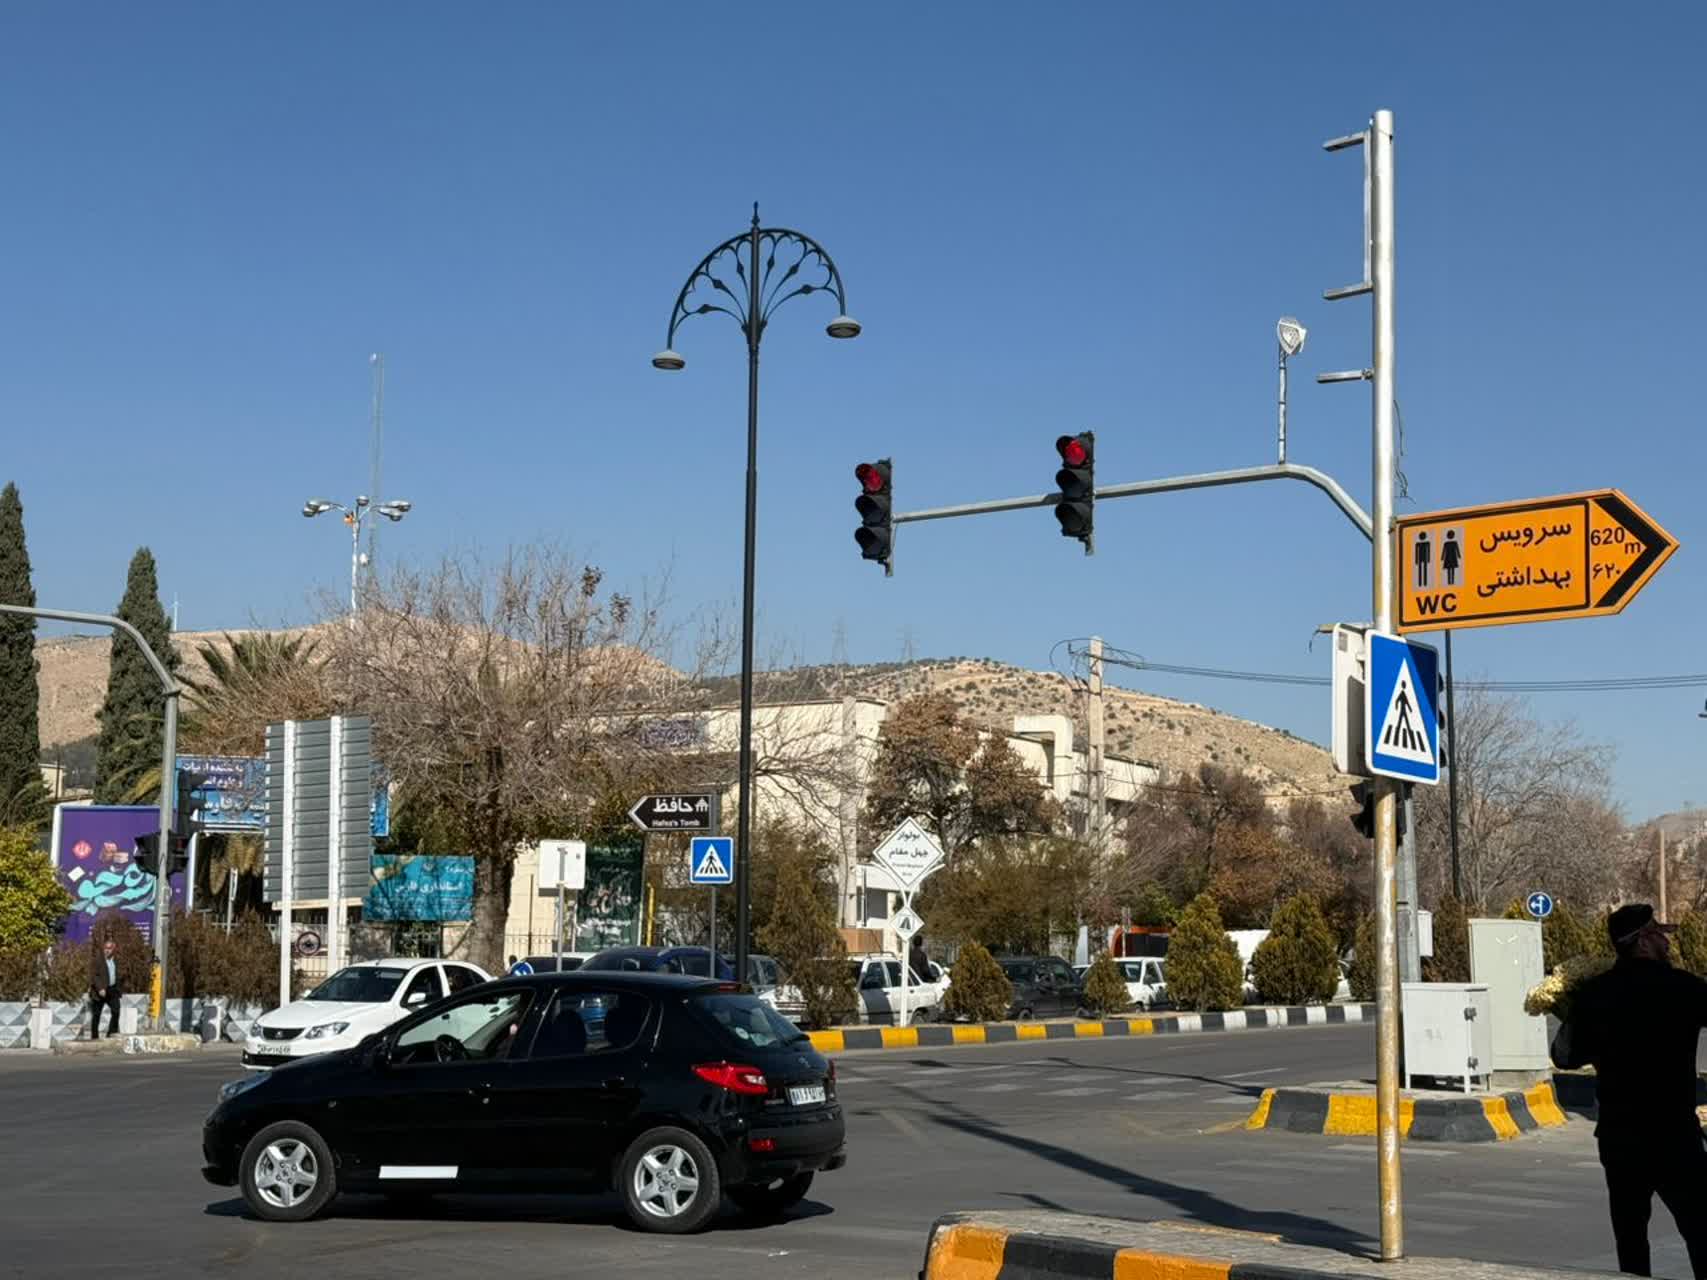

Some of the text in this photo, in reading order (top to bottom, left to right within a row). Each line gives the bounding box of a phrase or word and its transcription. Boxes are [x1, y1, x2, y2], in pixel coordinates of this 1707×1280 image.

[1479, 520, 1573, 552] سرویس
[1590, 527, 1641, 555] 620 m
[1592, 562, 1621, 580] ۶۲۰
[1476, 565, 1572, 598] بهداشتی
[1416, 593, 1457, 615] WC
[653, 797, 693, 812] حافظ
[680, 819, 700, 827] Tomb
[889, 848, 908, 858] مقام
